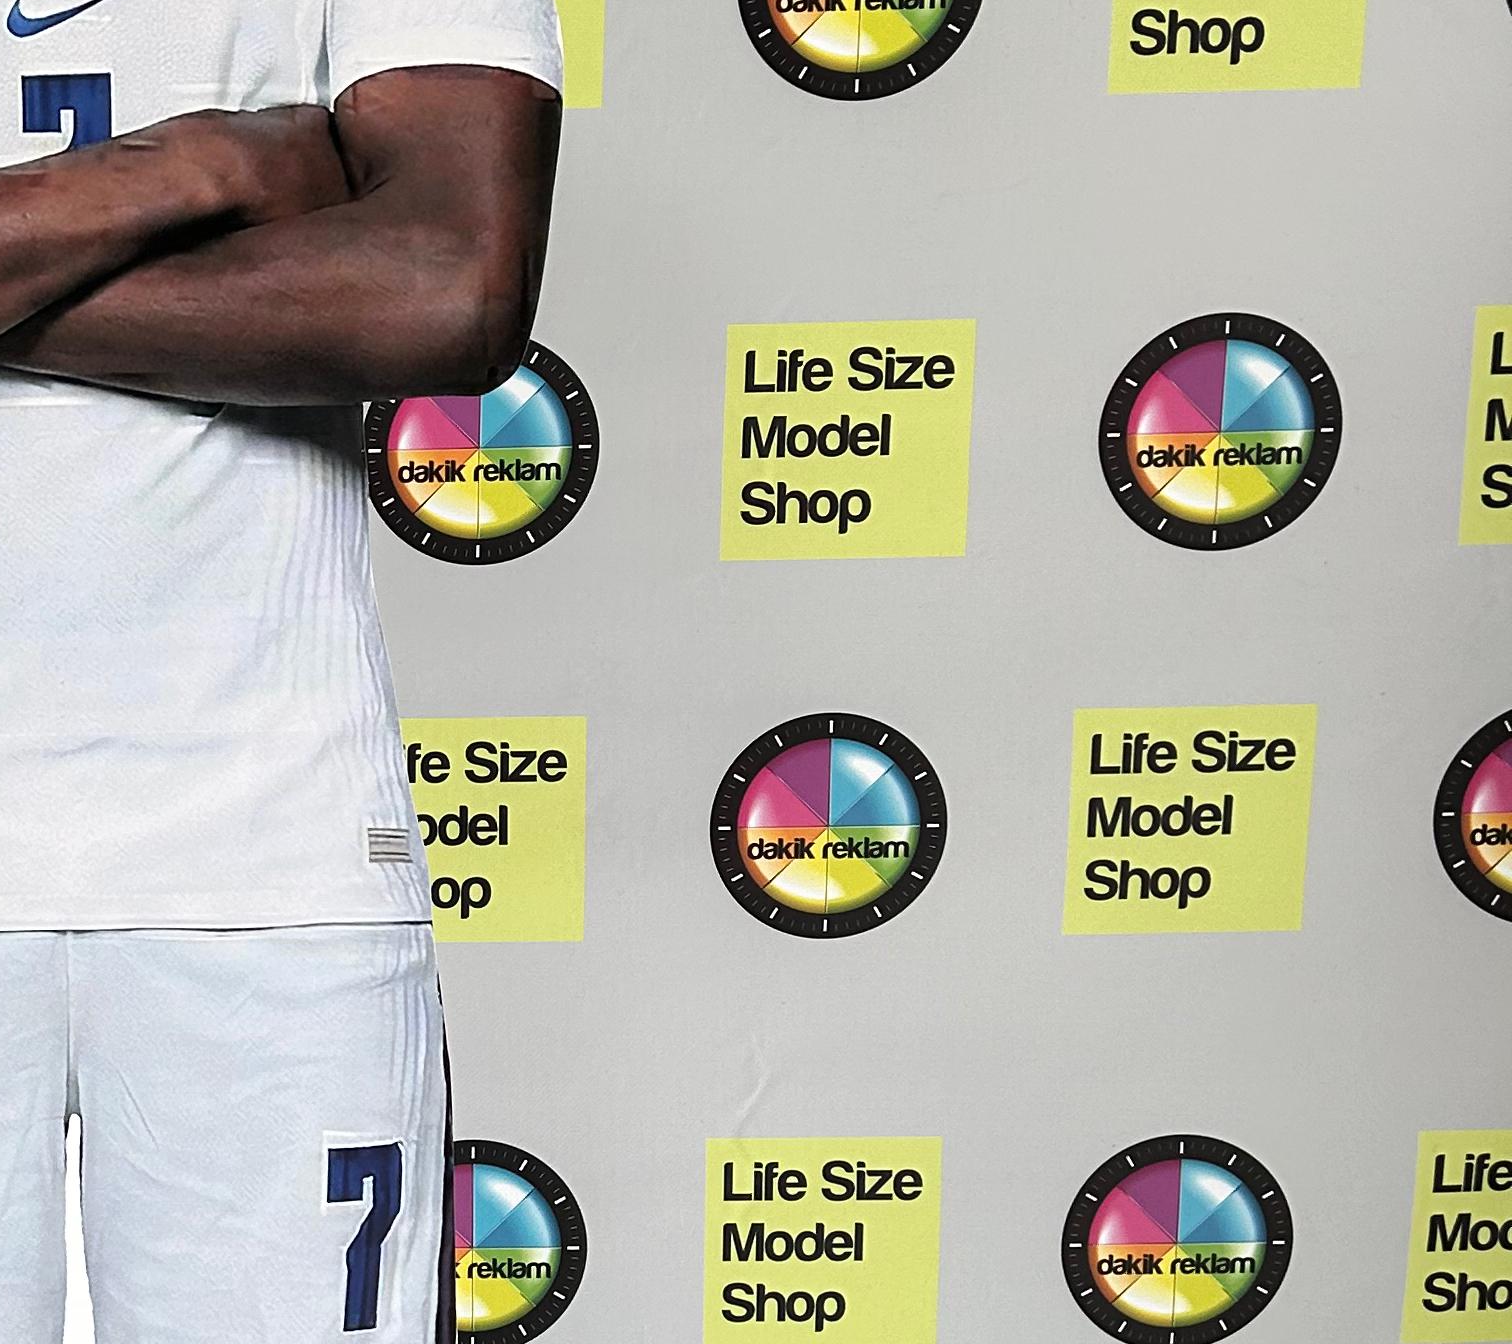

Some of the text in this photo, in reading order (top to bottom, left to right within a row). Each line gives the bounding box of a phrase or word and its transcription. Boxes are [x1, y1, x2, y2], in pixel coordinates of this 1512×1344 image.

[1129, 8, 1265, 66] Shop
[744, 346, 955, 394] Life Size
[741, 413, 892, 459] Model
[1136, 442, 1303, 468] dakik reklam
[398, 458, 562, 484] dakik reklam
[740, 481, 872, 535] Shop
[404, 741, 568, 784] fe Size
[1090, 730, 1297, 775] Life Size
[417, 804, 509, 847] odel
[1086, 794, 1234, 838] Model
[1470, 823, 1512, 846] dak
[747, 836, 910, 860] dakik reklam
[431, 876, 492, 920] op
[1083, 859, 1212, 910] Shop
[723, 1160, 924, 1202] Life Size
[1432, 1152, 1512, 1194] Life
[326, 1141, 403, 1333] 7
[722, 1222, 864, 1262] Model
[467, 1258, 551, 1279] reklam
[1097, 1253, 1256, 1275] dakik reklam
[721, 1282, 846, 1333] Shop
[1421, 1271, 1512, 1313] Sho
